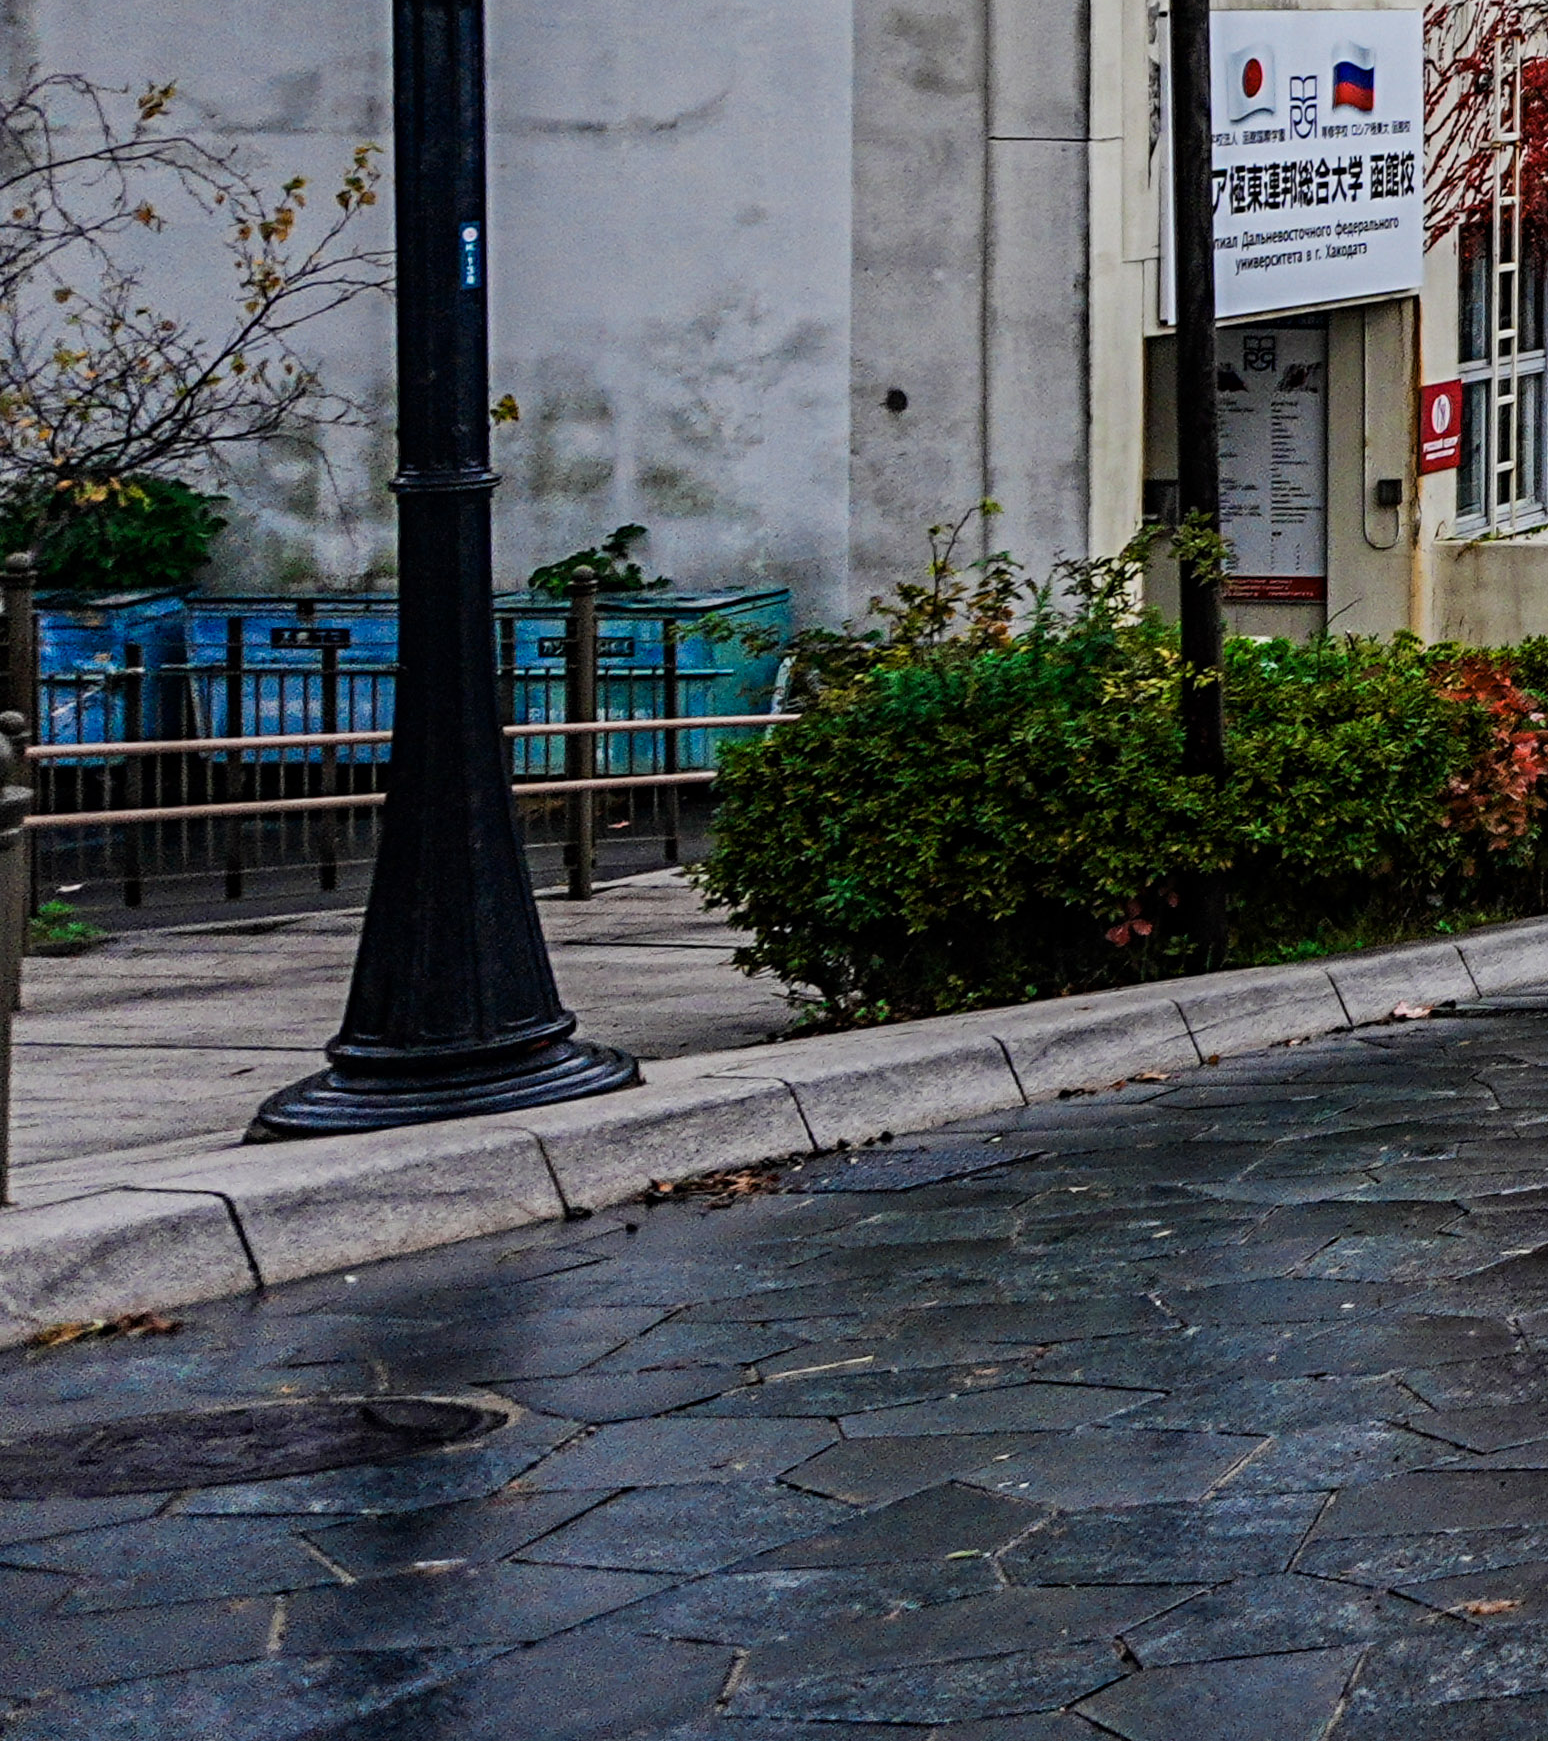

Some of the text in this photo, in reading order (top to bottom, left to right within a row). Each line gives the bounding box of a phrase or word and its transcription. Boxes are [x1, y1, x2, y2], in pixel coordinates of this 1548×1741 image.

[1370, 150, 1415, 201] 函館校
[1214, 217, 1400, 251] лиал Дальневосточного федерального
[1234, 250, 1303, 275] университета
[1325, 242, 1368, 260] Хакодатэ
